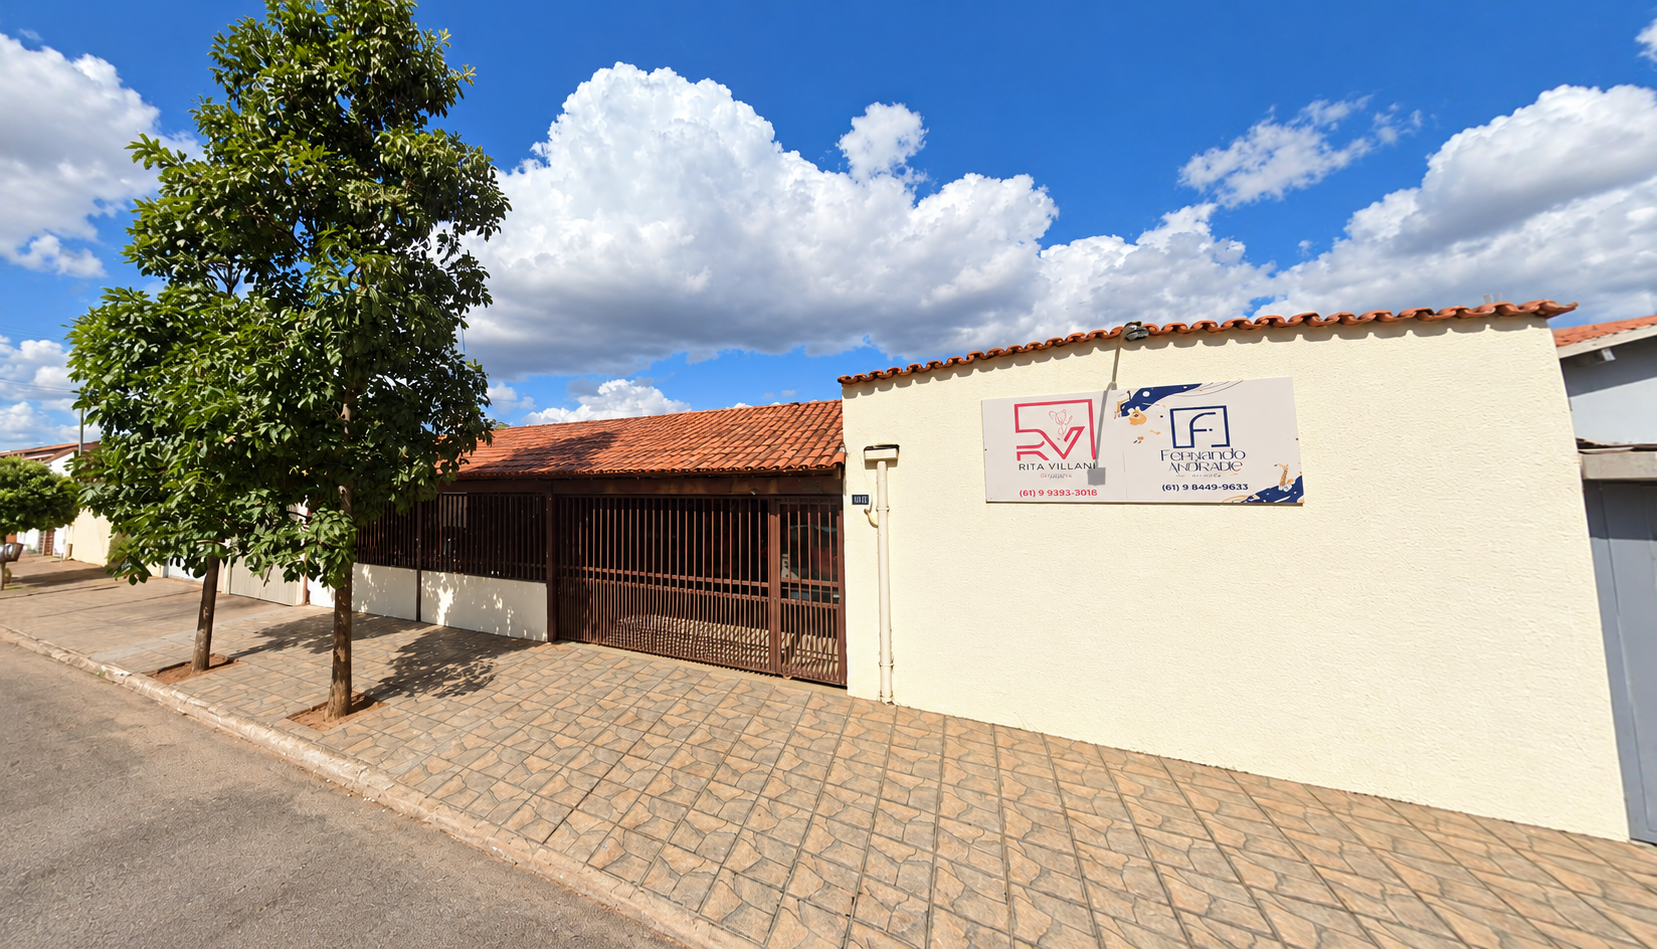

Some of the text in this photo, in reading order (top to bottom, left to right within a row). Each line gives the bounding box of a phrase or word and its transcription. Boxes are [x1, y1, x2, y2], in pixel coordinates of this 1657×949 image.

[1018, 462, 1097, 471] RITA VILLANI
[1161, 483, 1249, 492] (61) 9 8449-9633
[1019, 489, 1036, 498] (61)
[1038, 489, 1045, 497] 9
